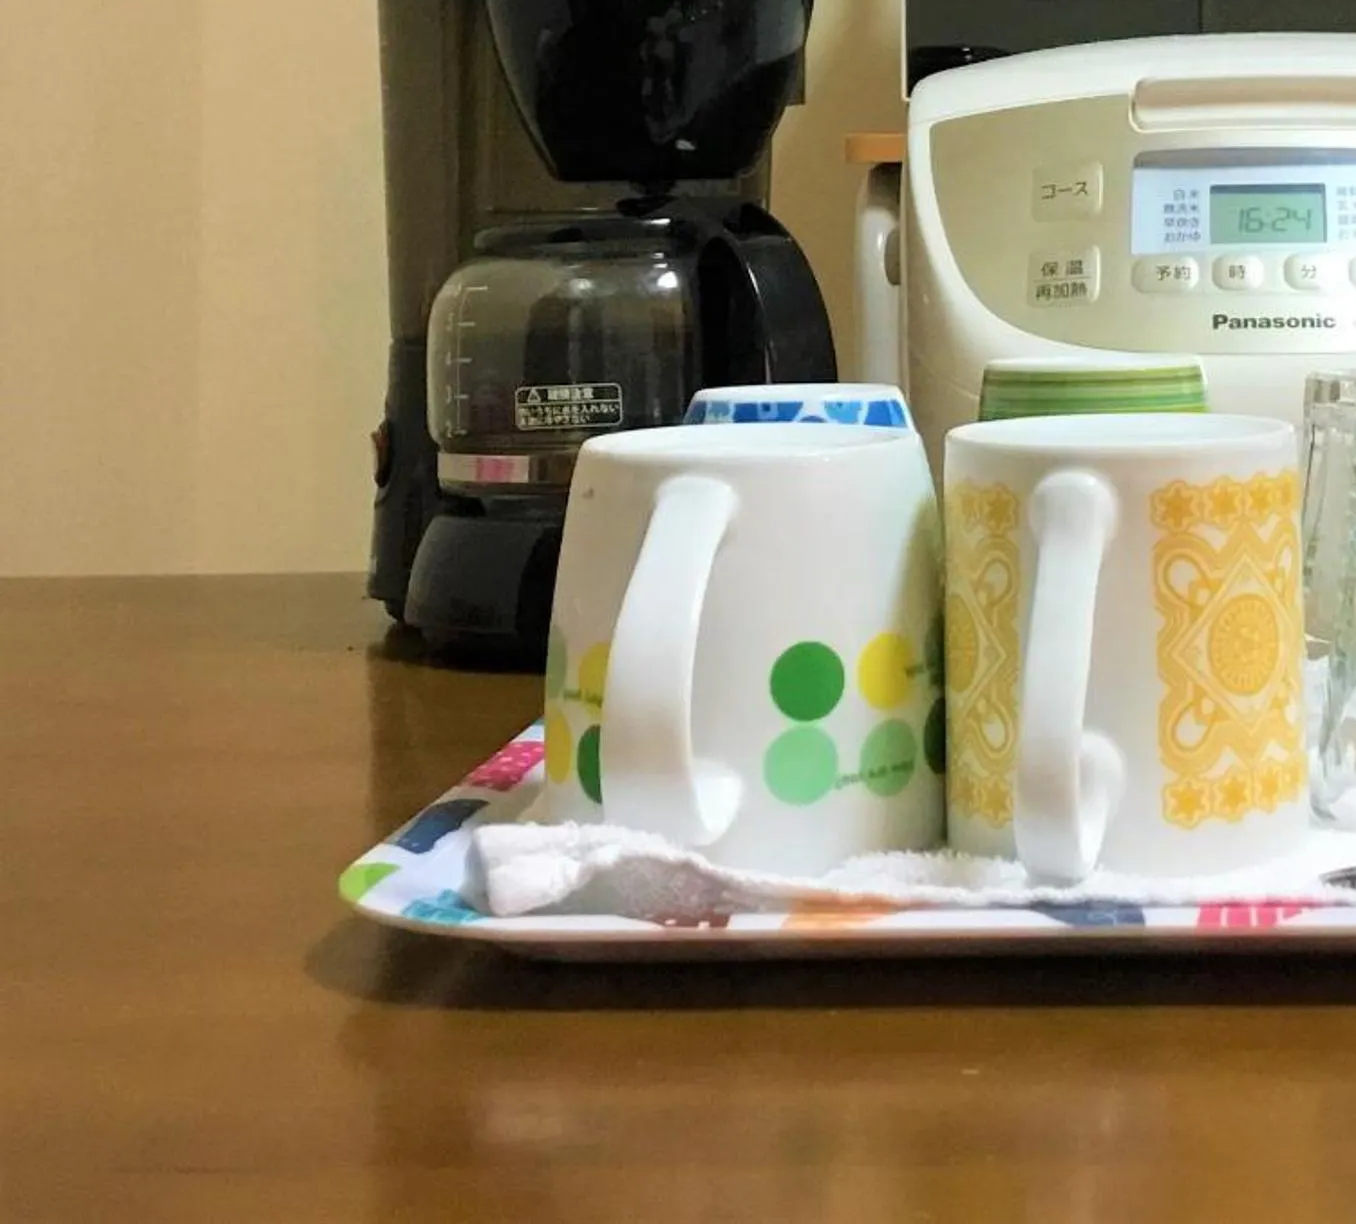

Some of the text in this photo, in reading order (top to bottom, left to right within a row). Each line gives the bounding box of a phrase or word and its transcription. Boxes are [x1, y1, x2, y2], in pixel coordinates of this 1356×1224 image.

[1041, 181, 1087, 200] コース
[1236, 206, 1312, 234] 16:24
[1155, 264, 1192, 281] 予約
[1228, 264, 1247, 280] 時
[1301, 264, 1317, 280] 分
[1212, 313, 1337, 331] Panasonic
